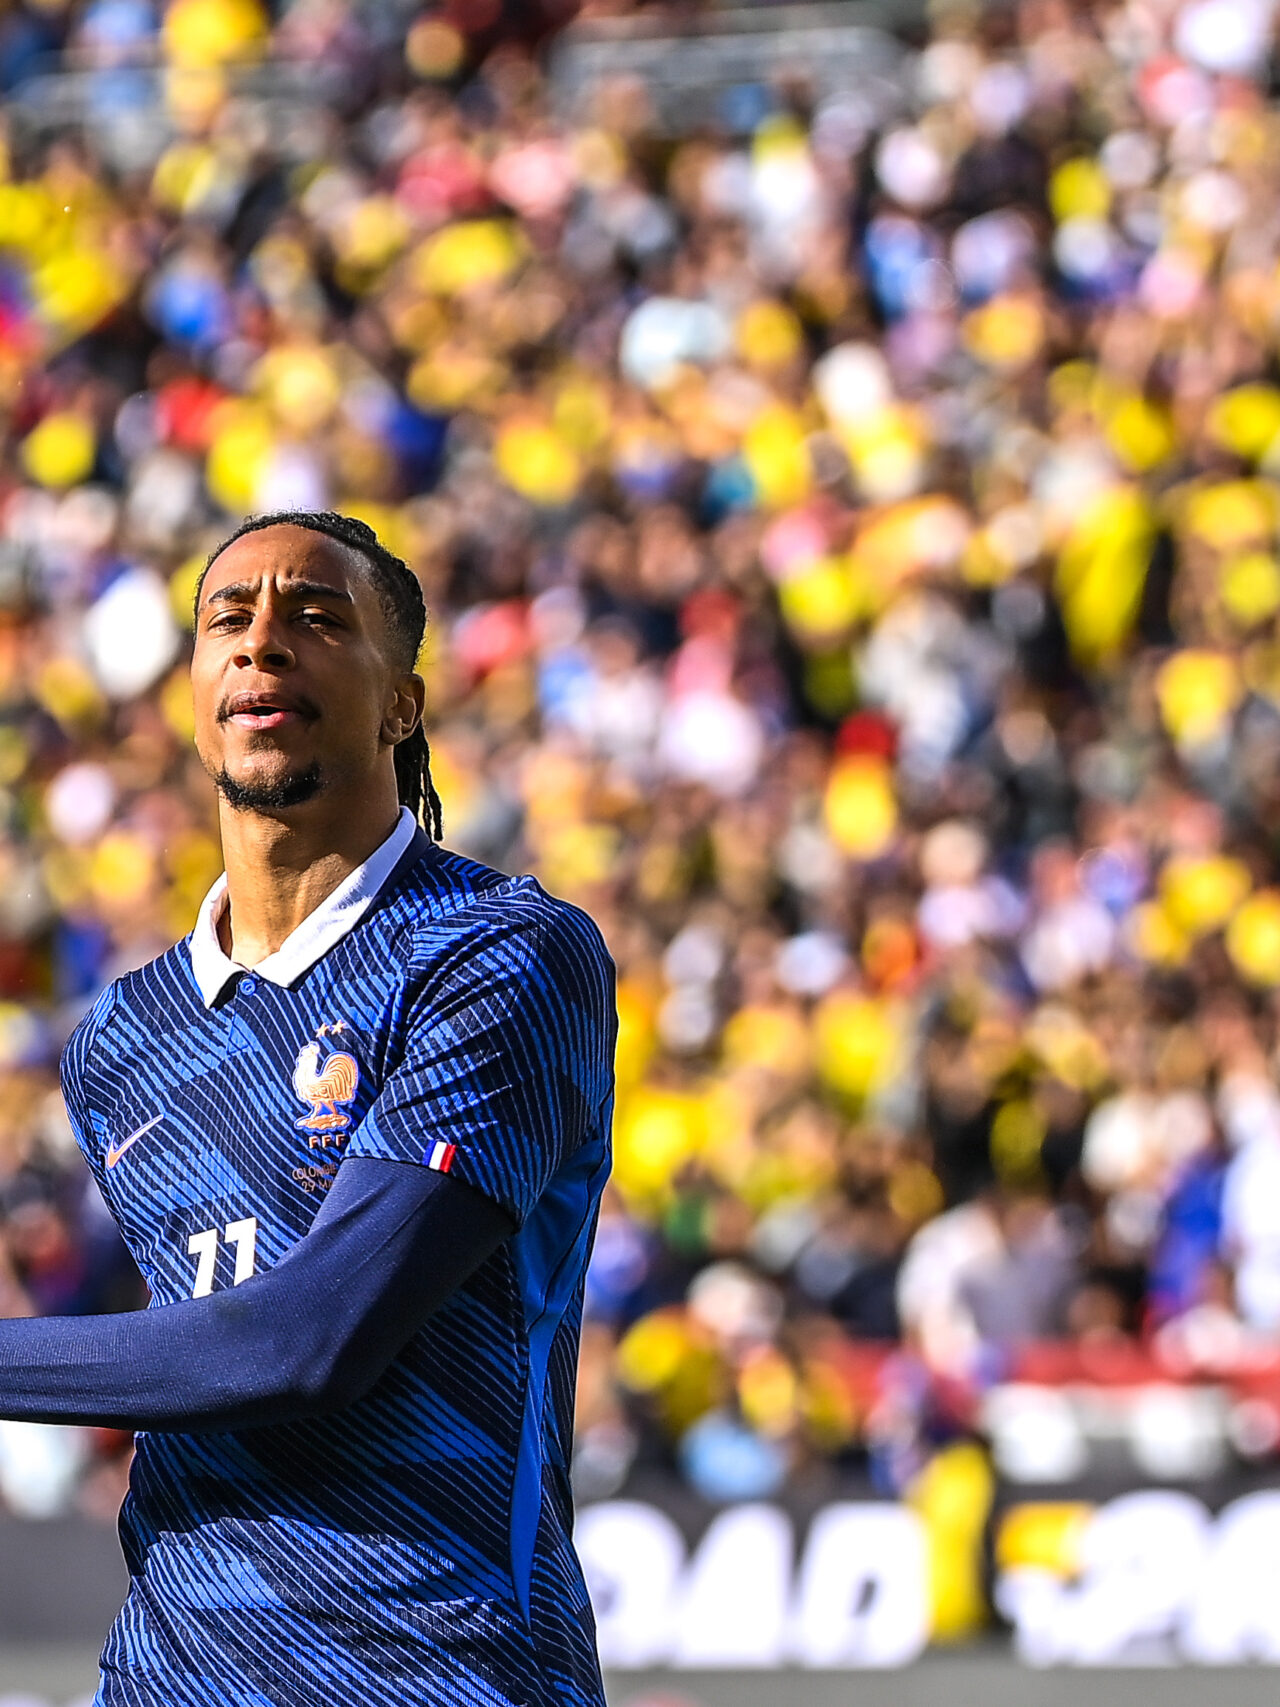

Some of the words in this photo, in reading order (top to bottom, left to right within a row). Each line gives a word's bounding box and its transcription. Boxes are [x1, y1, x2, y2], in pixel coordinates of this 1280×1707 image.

[309, 1134, 345, 1149] FFF
[302, 1180, 316, 1192] 29
[188, 1216, 256, 1299] 11
